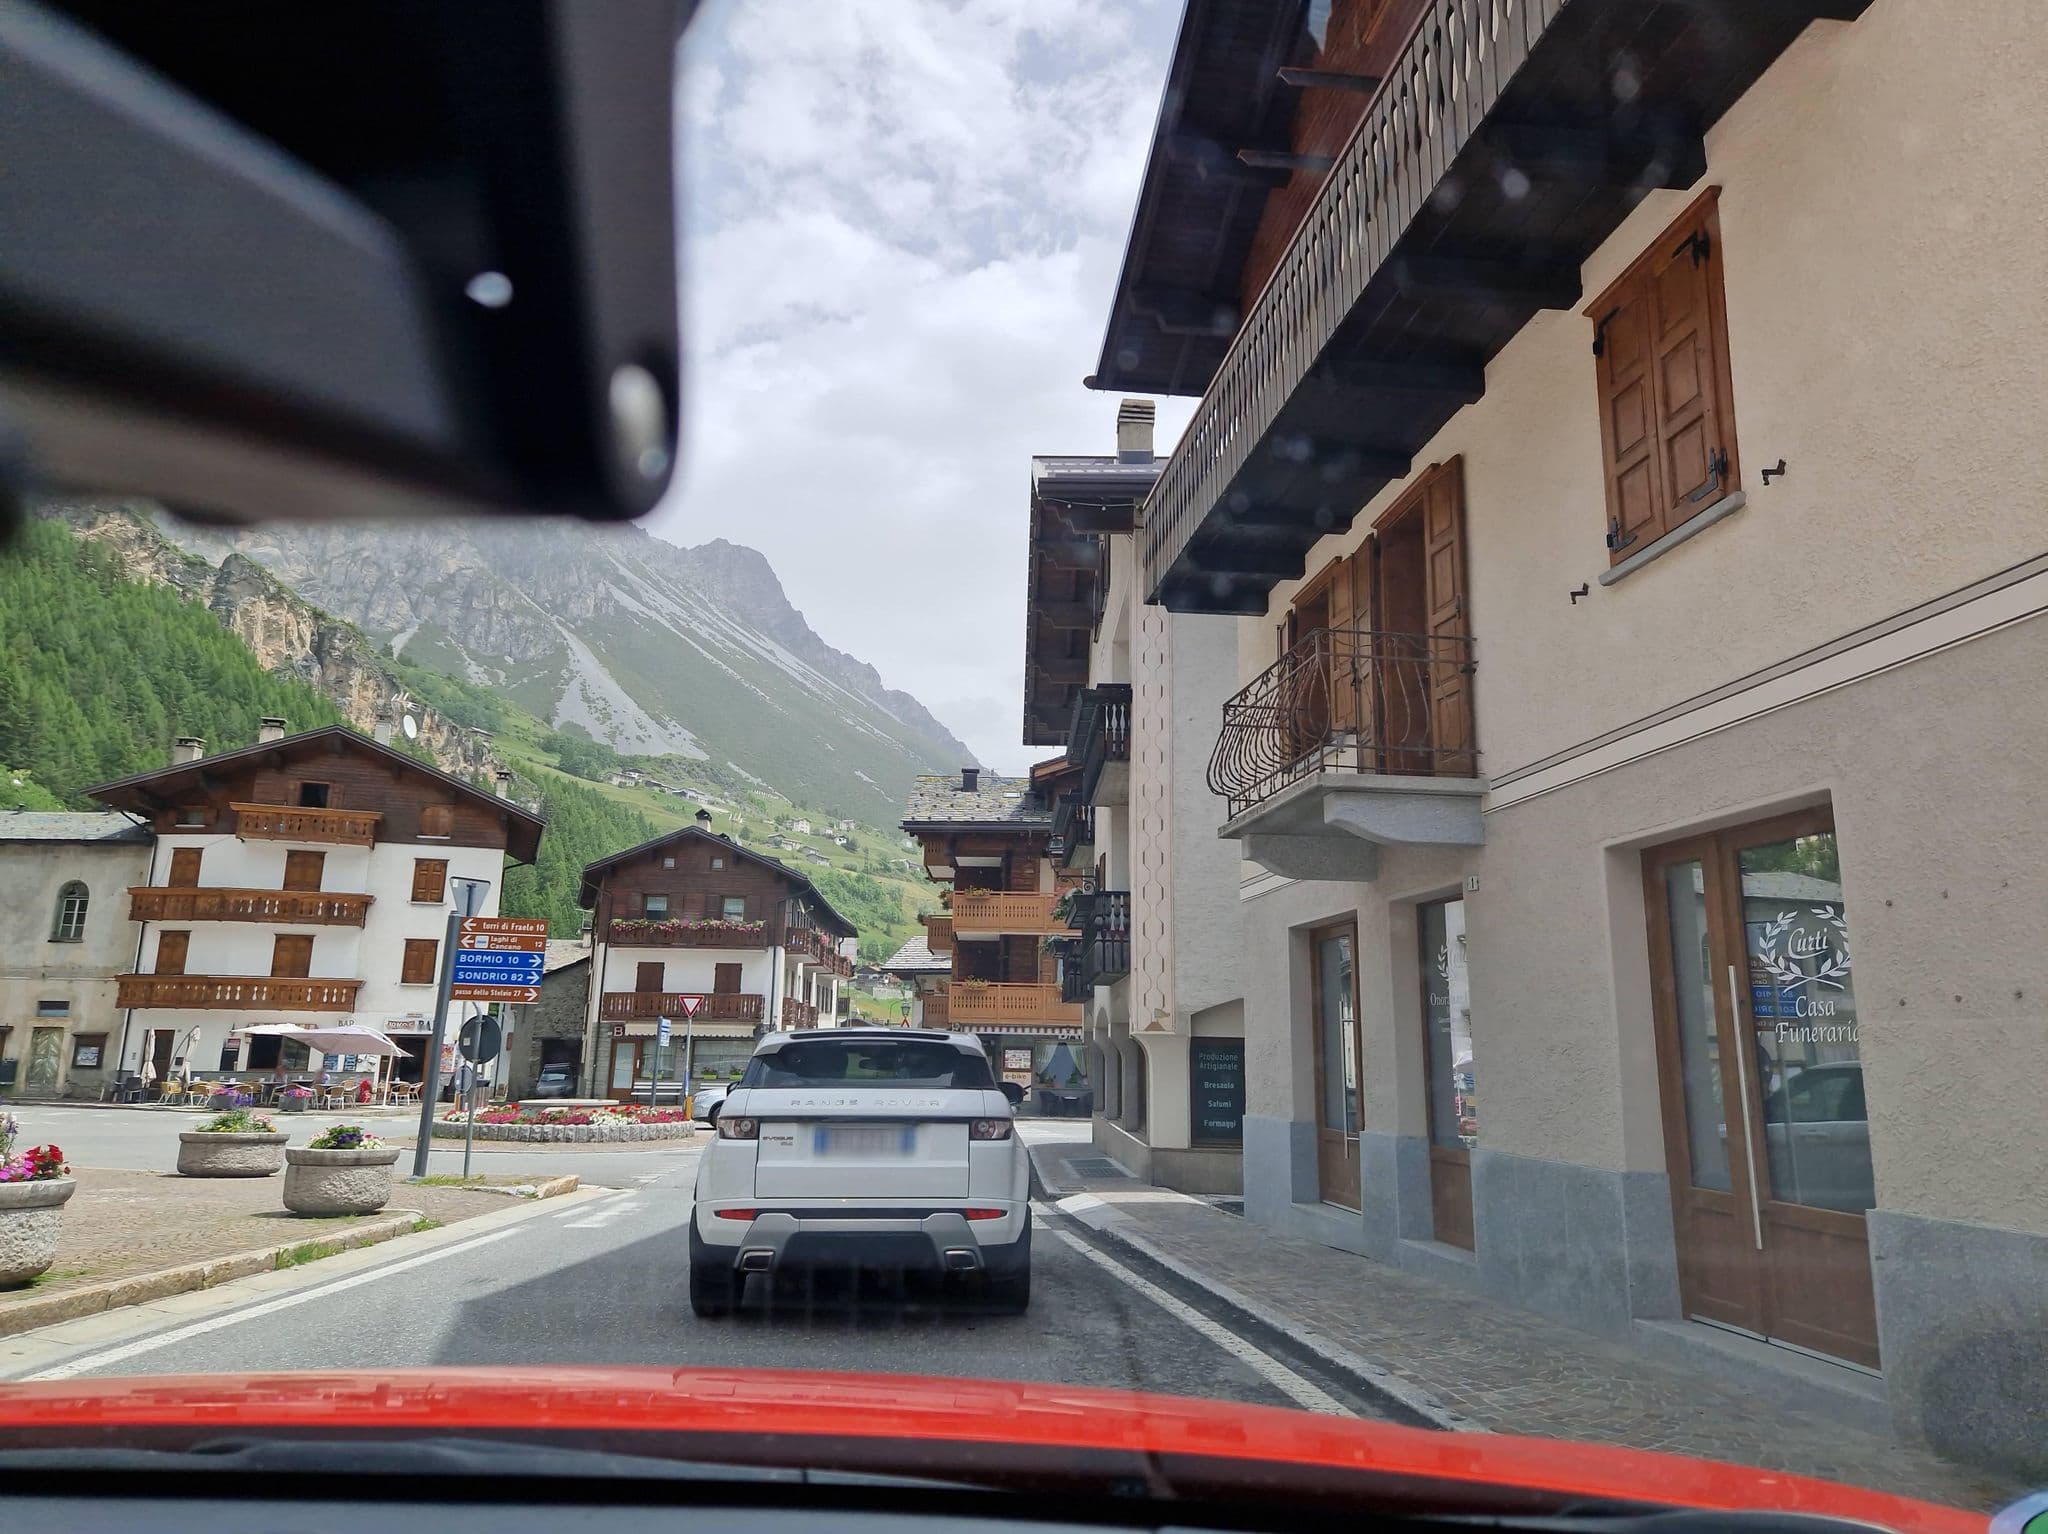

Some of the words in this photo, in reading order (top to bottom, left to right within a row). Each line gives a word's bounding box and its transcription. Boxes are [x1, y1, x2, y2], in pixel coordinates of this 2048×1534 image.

[501, 922, 508, 931] di
[511, 923, 534, 932] Fraele
[536, 924, 545, 932] 10
[489, 943, 522, 951] Cancano
[1788, 928, 1830, 959] Curti
[460, 954, 503, 964] BORMIO
[508, 956, 519, 965] 10
[457, 971, 508, 981] SONDRIO
[511, 973, 524, 982] 82
[1796, 996, 1836, 1017] Casa
[1199, 1053, 1239, 1061] Produzione
[1200, 1062, 1239, 1071] Artigianale
[790, 1098, 858, 1106] RANGE
[873, 1098, 940, 1106] ROVER
[1208, 1100, 1232, 1108] Salumi
[1204, 1120, 1237, 1128] Formaggi
